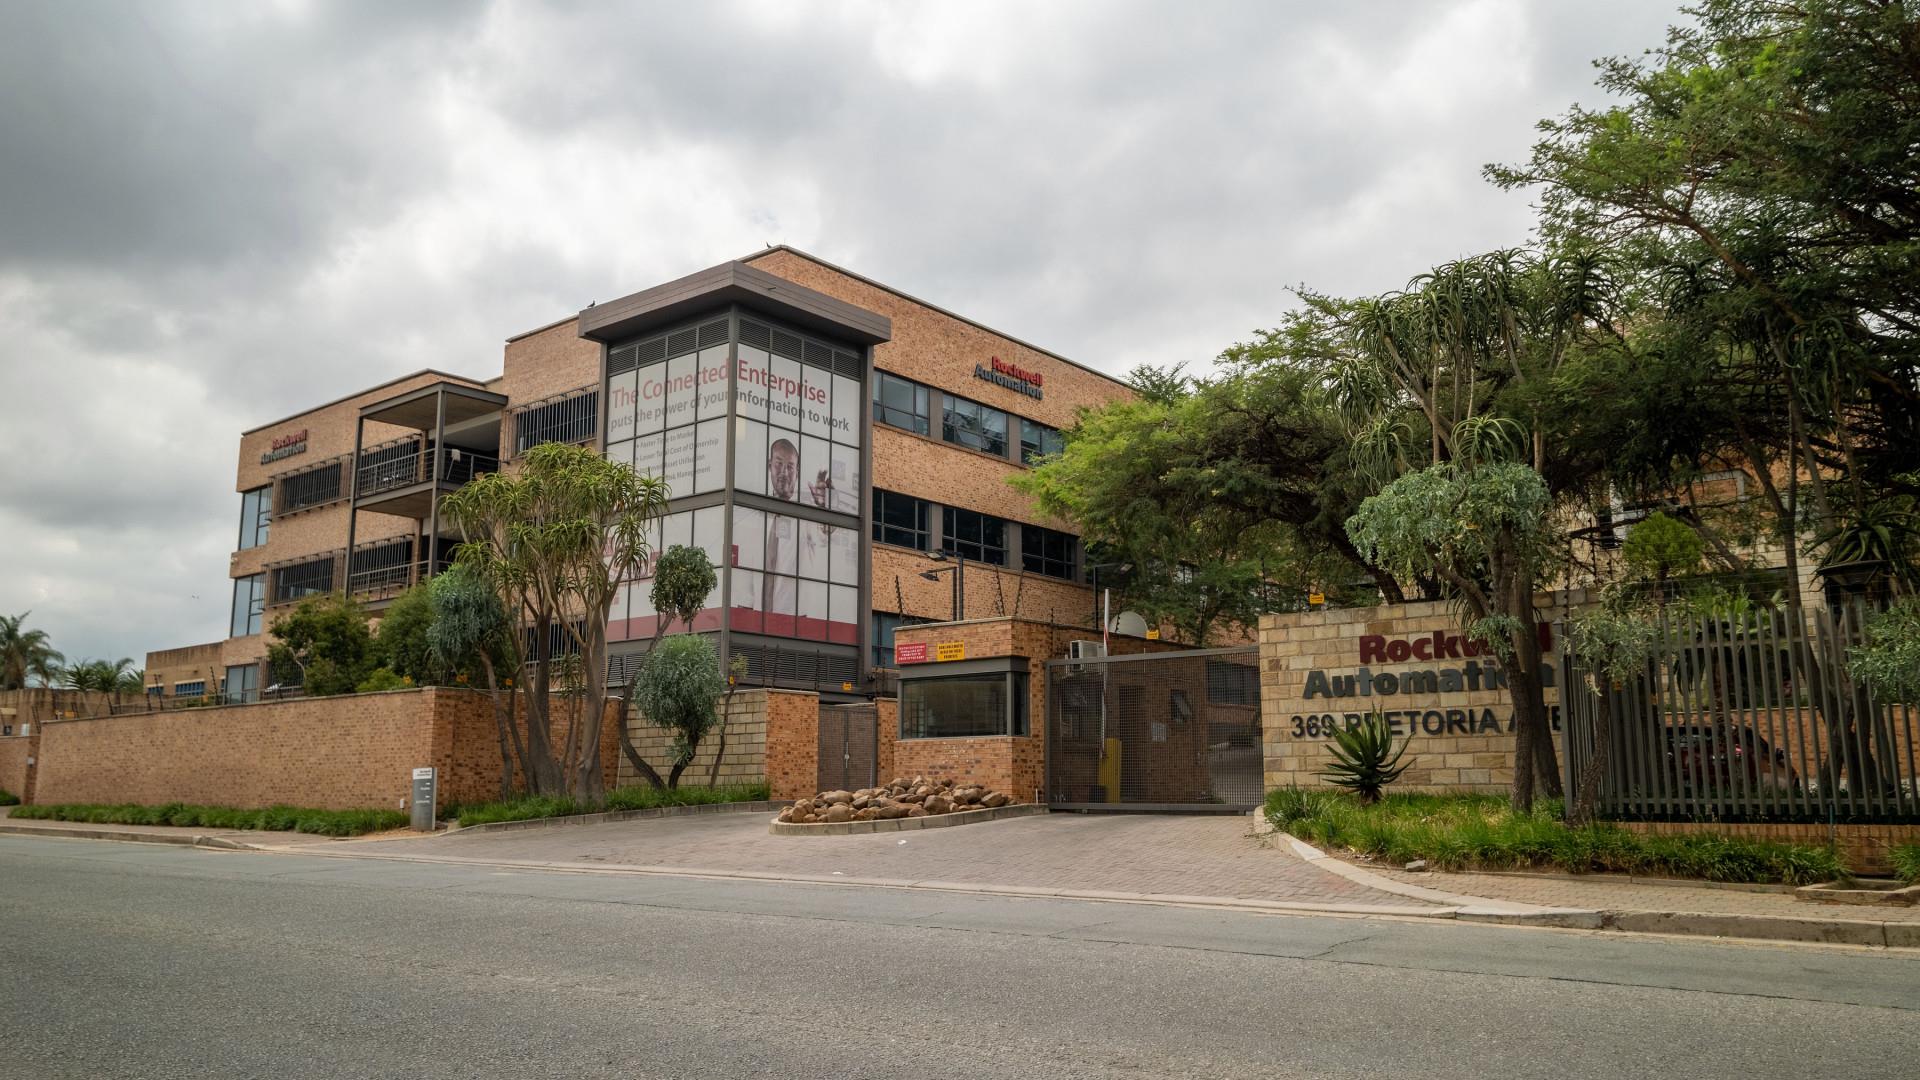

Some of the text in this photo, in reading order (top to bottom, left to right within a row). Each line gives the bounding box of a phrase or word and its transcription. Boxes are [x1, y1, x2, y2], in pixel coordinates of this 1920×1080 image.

[612, 358, 826, 409] The Connected Enterprise
[973, 361, 1043, 401] Automation
[991, 356, 1043, 386] Rockwell
[610, 414, 633, 432] puts
[654, 401, 688, 421] power
[689, 393, 702, 409] of
[736, 387, 805, 419] information
[808, 409, 820, 423] to
[823, 415, 850, 432] work
[1360, 622, 1552, 665] Rockwl
[1291, 714, 1335, 738] 369
